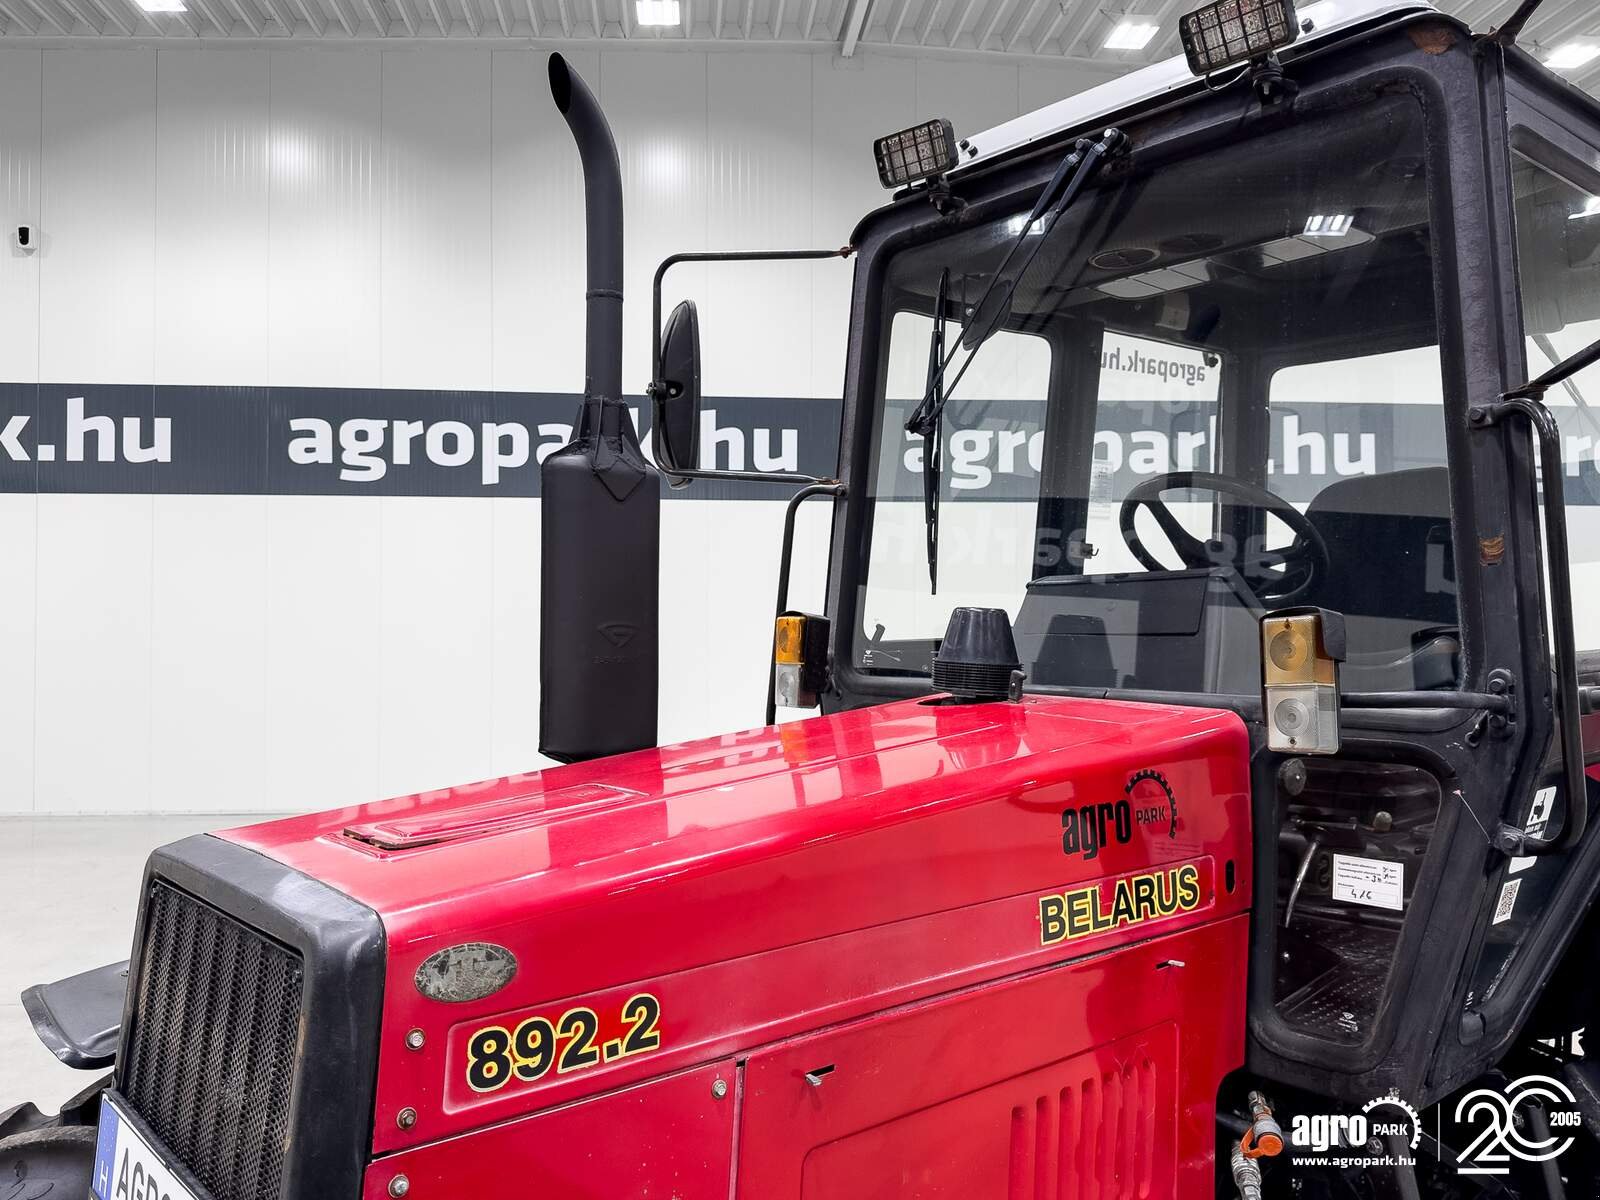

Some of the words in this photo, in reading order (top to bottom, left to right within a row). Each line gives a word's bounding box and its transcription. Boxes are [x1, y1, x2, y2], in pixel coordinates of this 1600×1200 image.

[1062, 800, 1132, 860] agro
[1136, 806, 1166, 825] PARK
[1039, 865, 1200, 945] BELARUS
[466, 993, 660, 1092] 892.2
[98, 1160, 109, 1198] H
